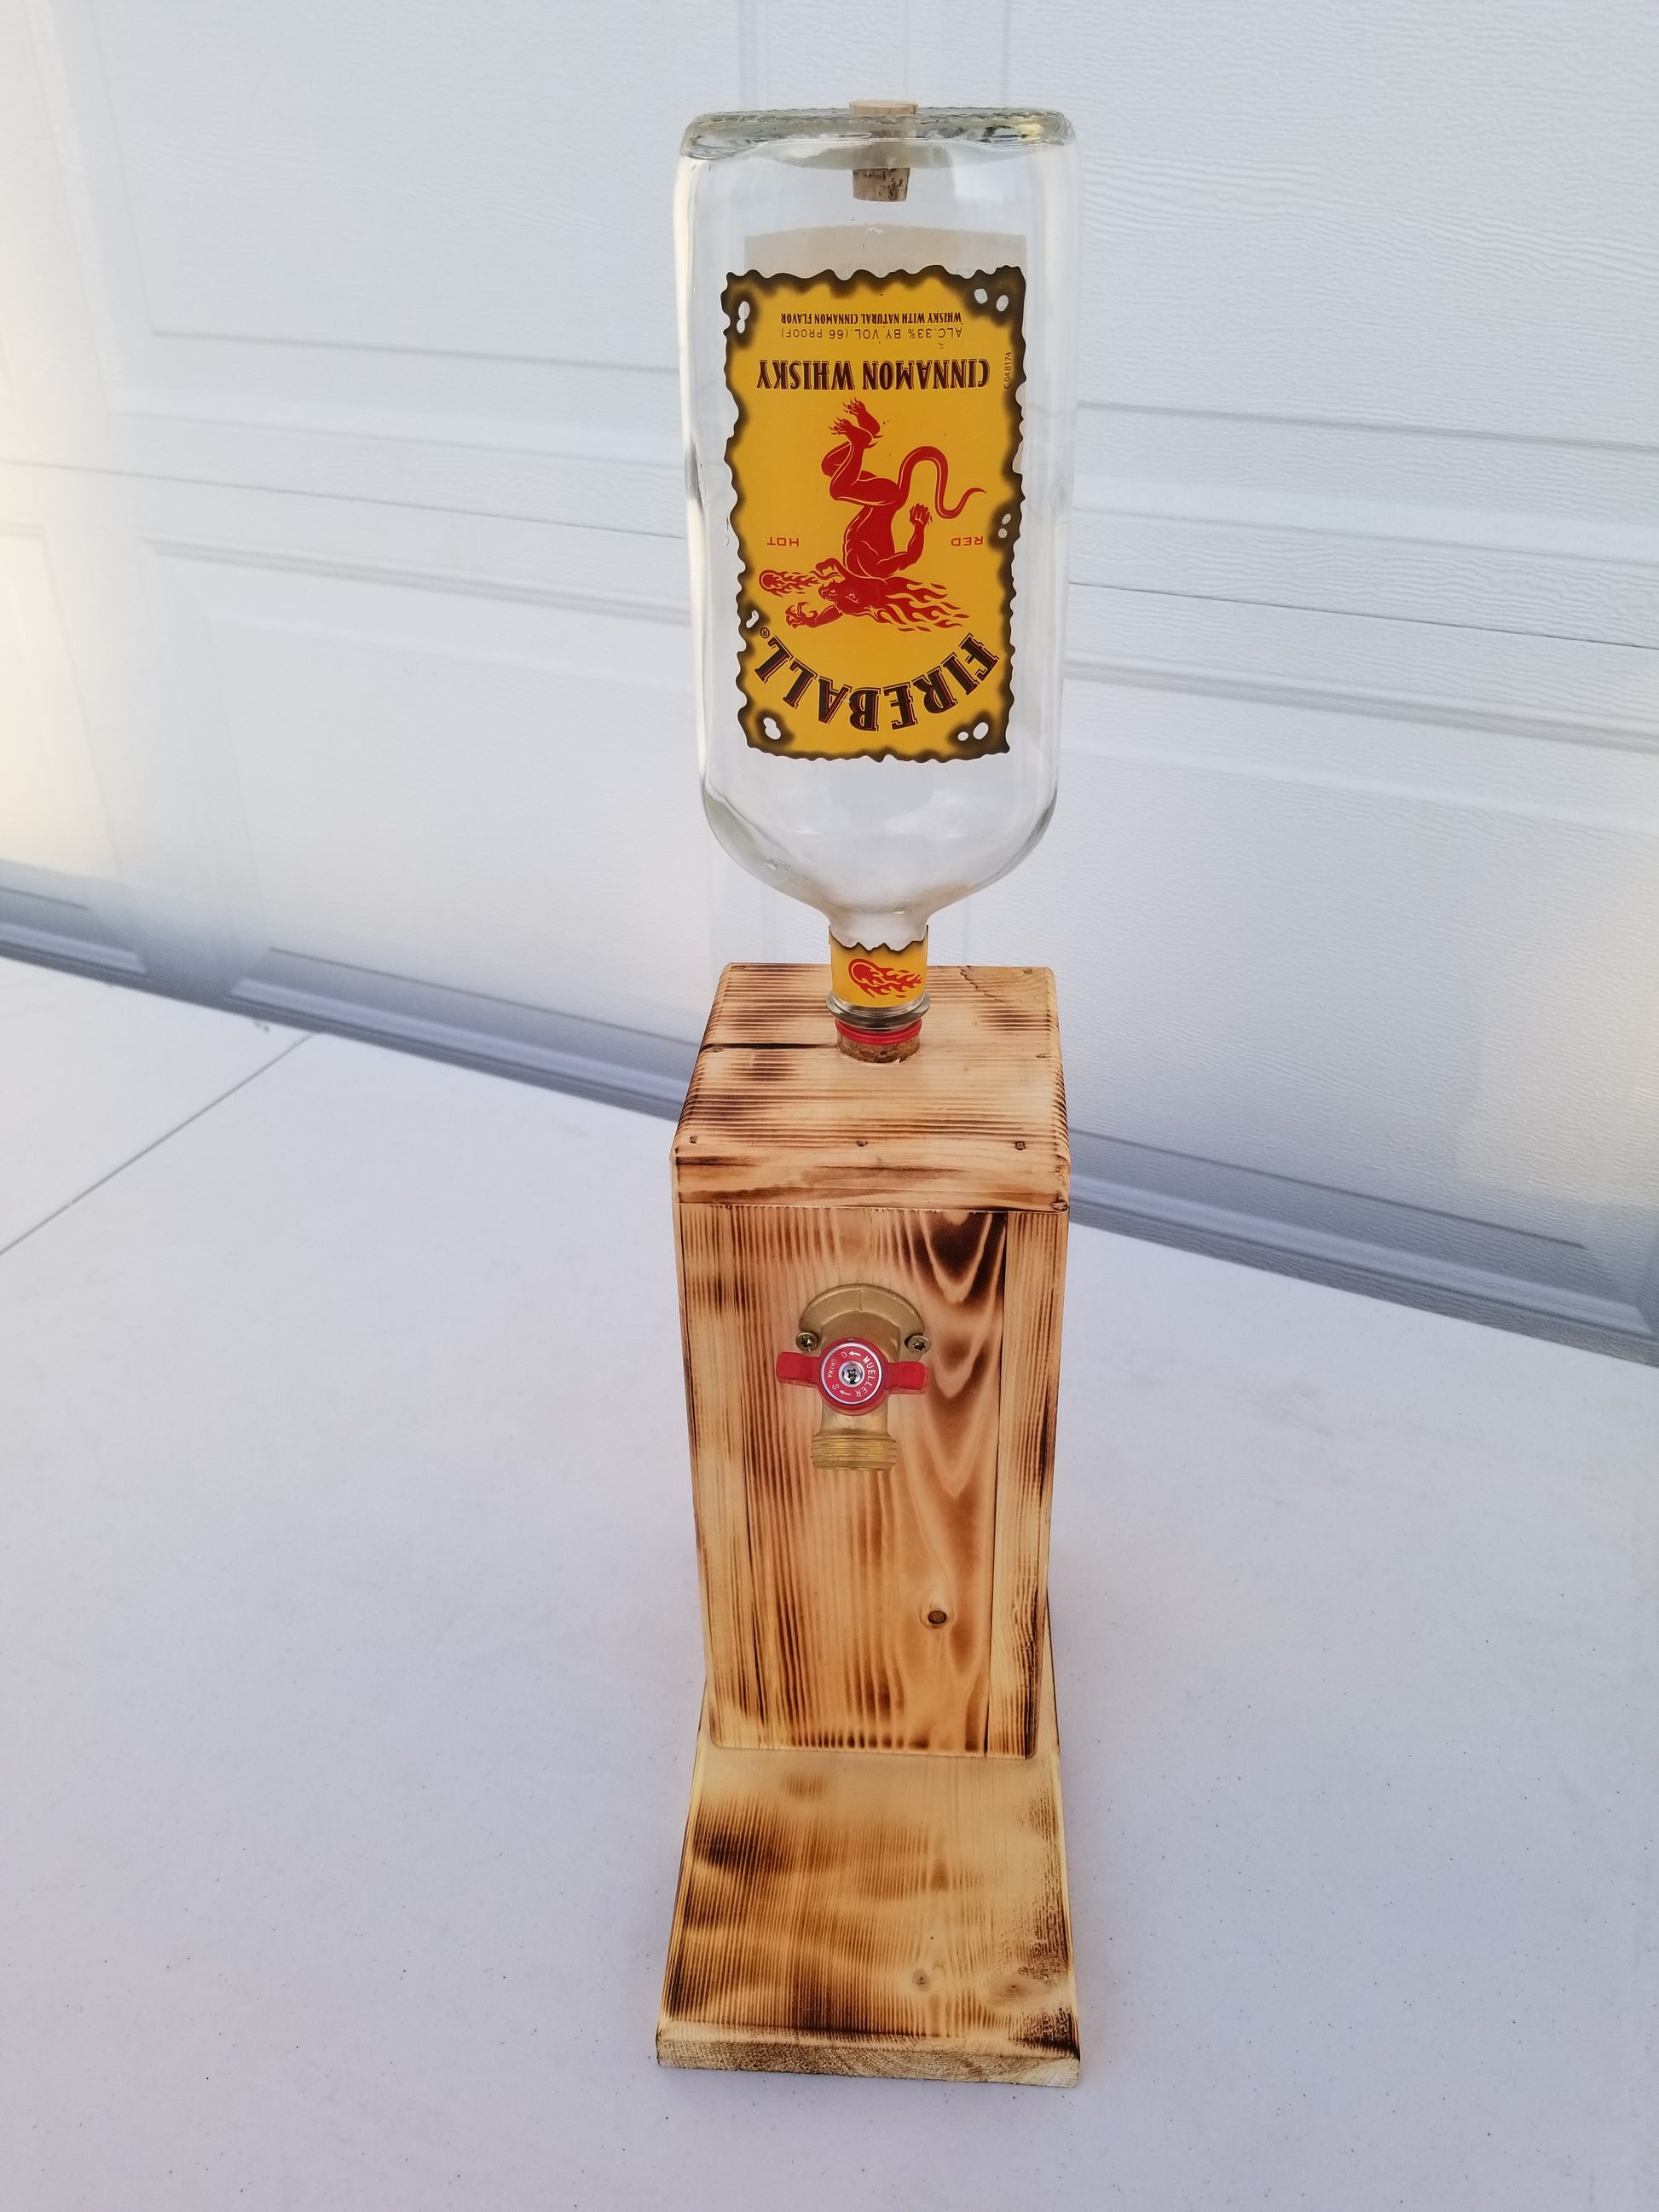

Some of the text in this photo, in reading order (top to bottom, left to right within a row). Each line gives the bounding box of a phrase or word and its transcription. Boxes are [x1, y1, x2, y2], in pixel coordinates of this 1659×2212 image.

[780, 312, 962, 324] WHISKY WITH NATURAL CINNAMON FLAVOR
[780, 328, 823, 338] PROOF)
[886, 328, 901, 339] BY
[756, 360, 990, 390] CINNAMON WHISKY
[766, 536, 799, 546] HOT
[951, 536, 983, 546] RED
[827, 1358, 836, 1377] CHINA
[855, 1355, 876, 1397] MUELLER
